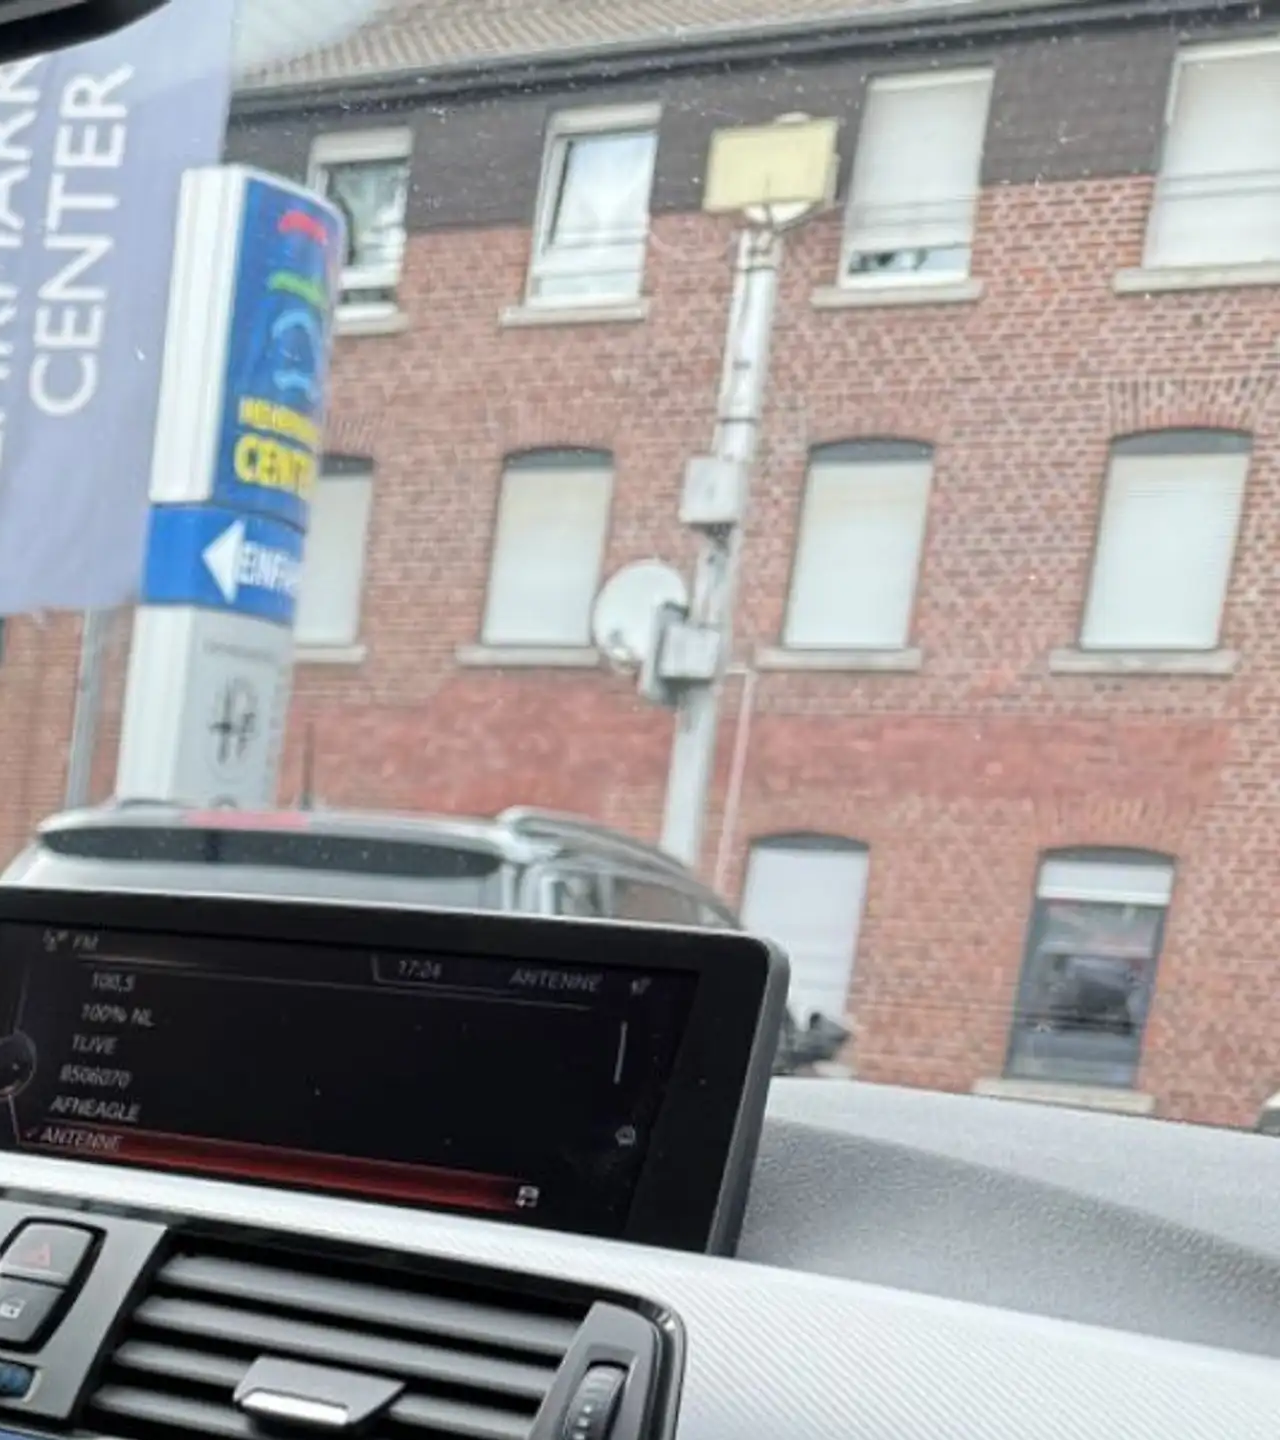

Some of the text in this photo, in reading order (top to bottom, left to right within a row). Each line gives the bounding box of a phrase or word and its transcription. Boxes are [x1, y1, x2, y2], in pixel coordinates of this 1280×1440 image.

[28, 62, 136, 418] CENTER
[397, 959, 443, 981] 17:24
[508, 967, 604, 993] ANTENNE
[81, 1003, 128, 1023] 100%
[40, 1126, 124, 1152] ANTENNE
